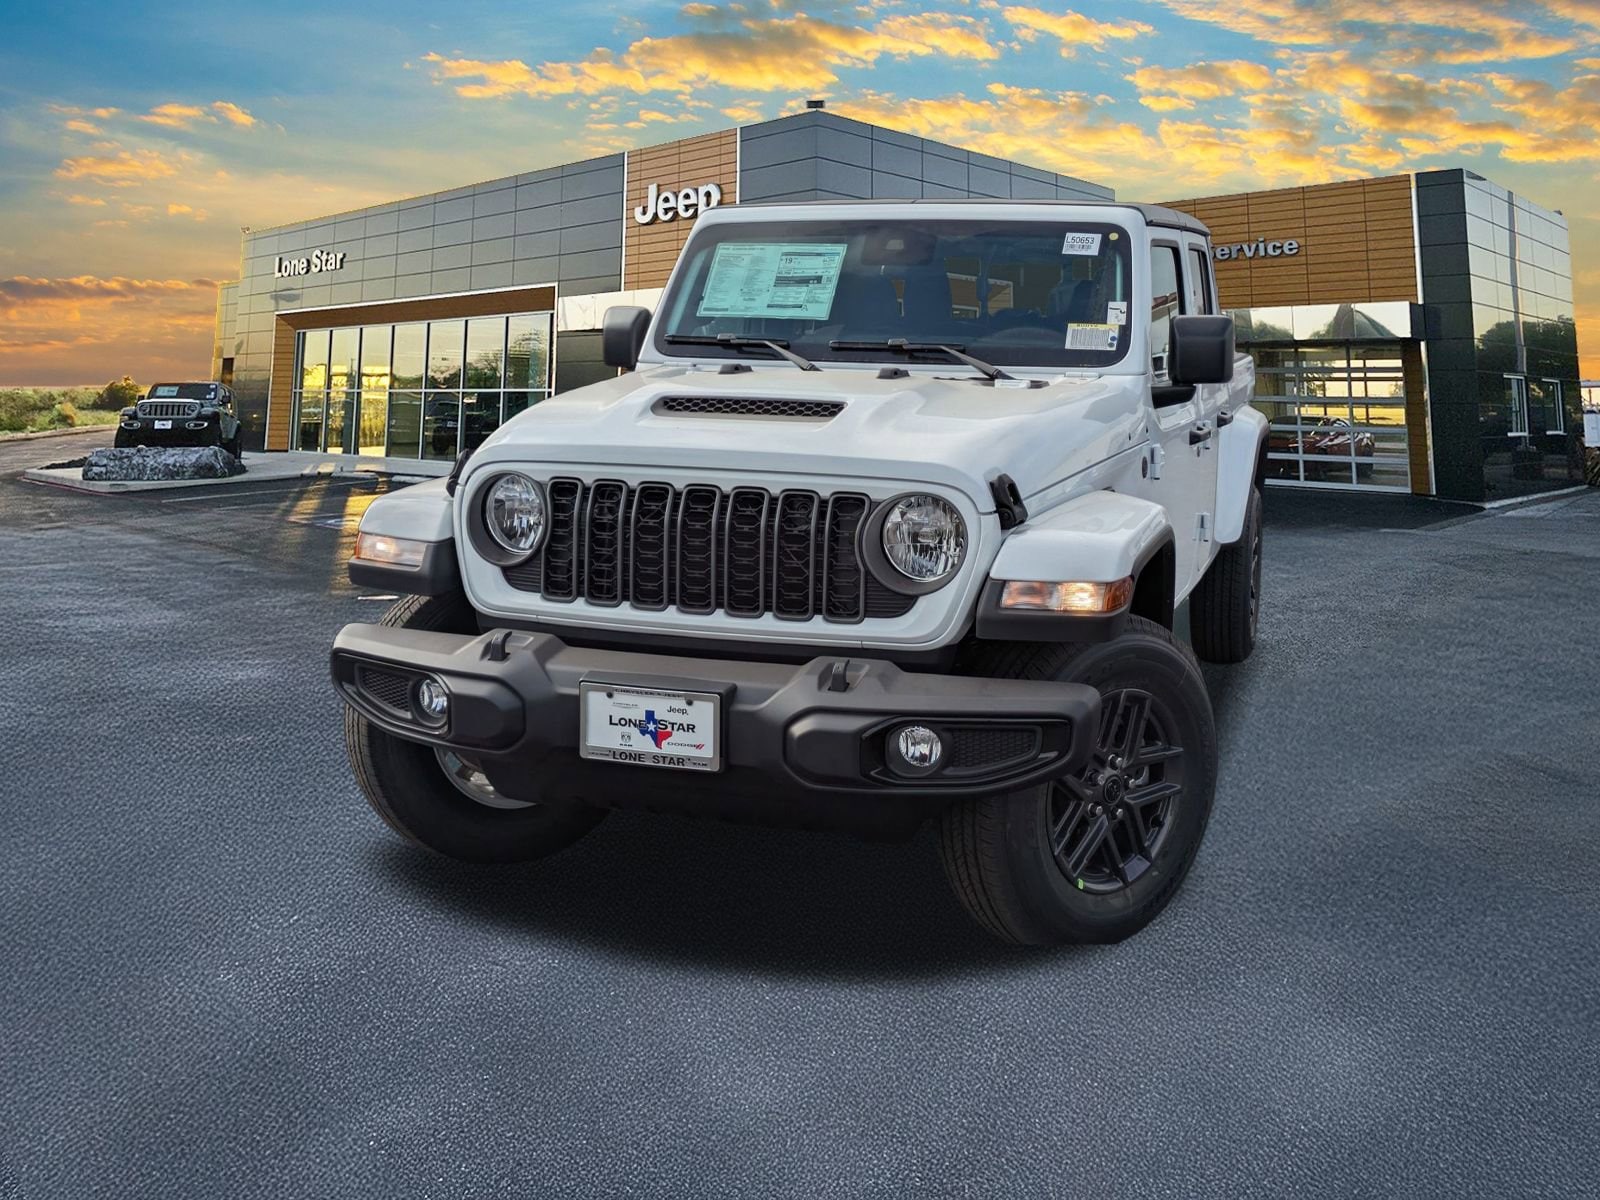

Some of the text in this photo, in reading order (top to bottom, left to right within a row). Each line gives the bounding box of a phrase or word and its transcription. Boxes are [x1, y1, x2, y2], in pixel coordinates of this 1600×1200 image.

[634, 183, 721, 225] Jeep
[1065, 235, 1095, 245] L50653
[274, 249, 345, 278] Lone Star
[667, 705, 688, 716] Jeep
[609, 715, 696, 734] LONE STAR
[612, 751, 646, 763] LONE
[652, 754, 686, 767] STAR
